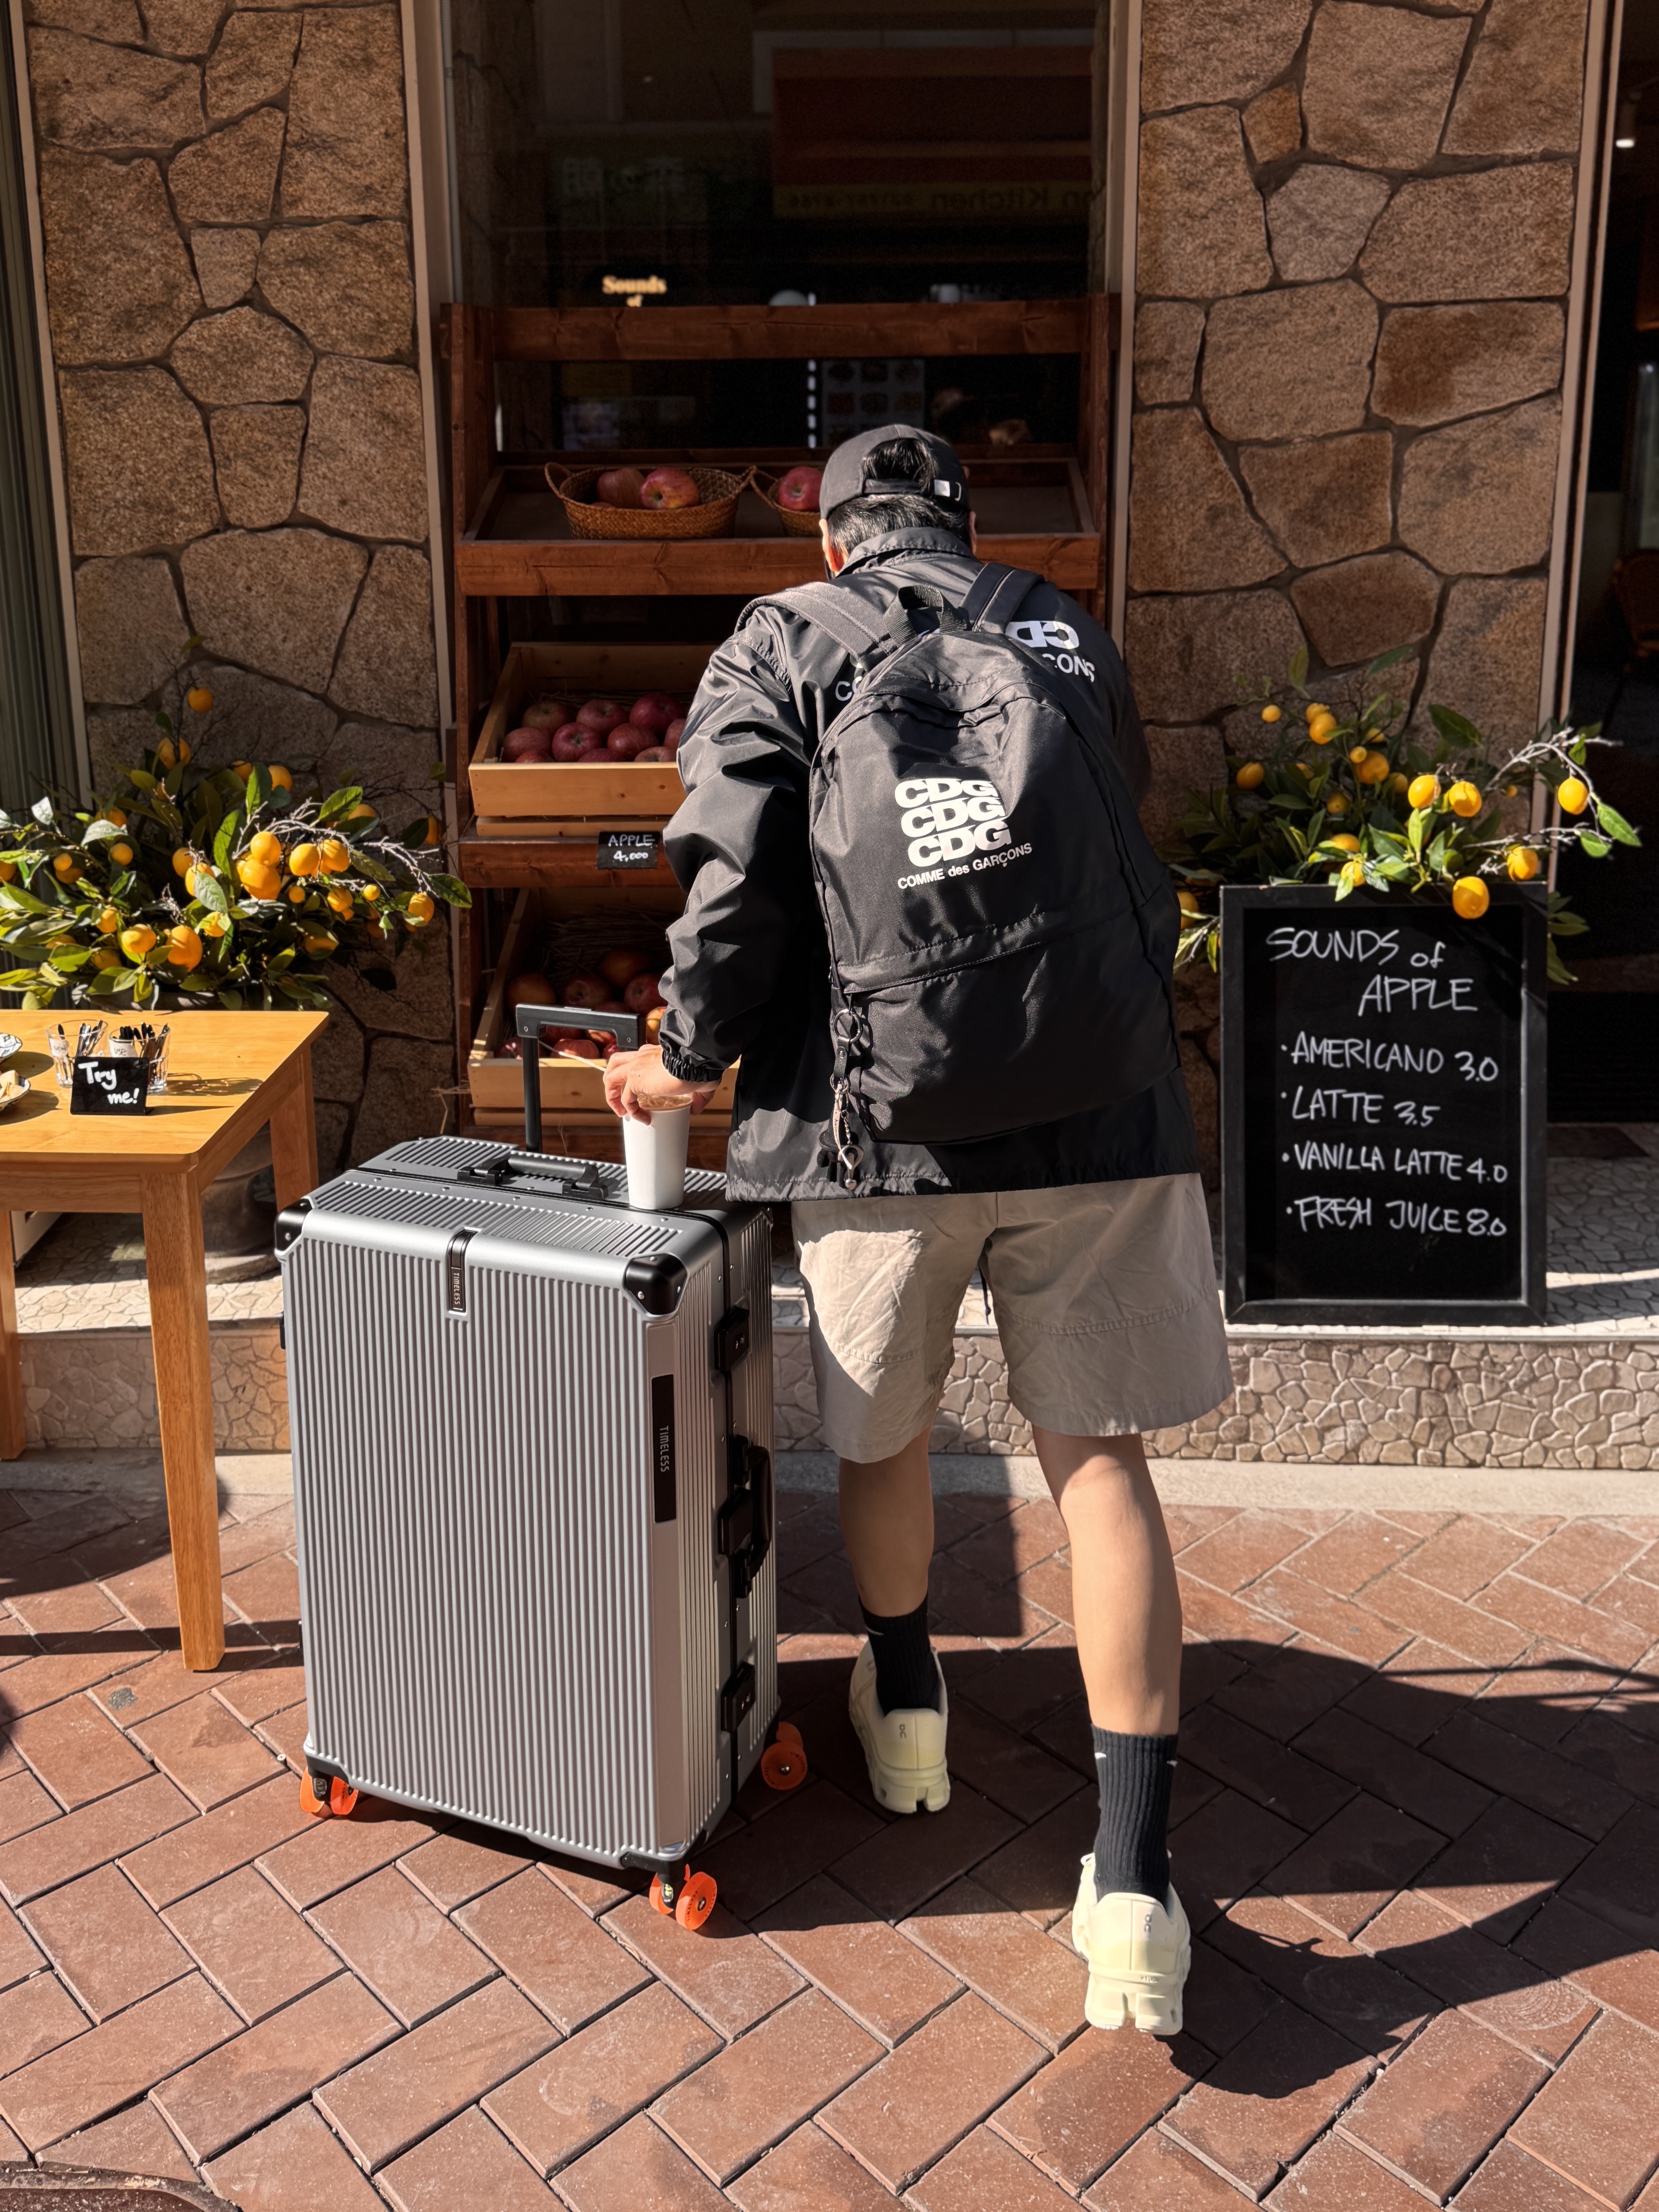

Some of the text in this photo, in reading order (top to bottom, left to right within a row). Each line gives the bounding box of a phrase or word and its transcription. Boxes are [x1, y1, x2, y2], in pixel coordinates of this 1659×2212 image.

[602, 275, 667, 294] Sounds
[894, 778, 999, 808] CDG
[901, 796, 1006, 837] CDG
[608, 833, 655, 847] APPLE
[613, 850, 649, 862] 4,000
[907, 819, 1012, 867] CDG
[897, 842, 1033, 889] COMME des GARÇONS
[1266, 927, 1446, 969] SOUNDS of
[1357, 974, 1478, 1017] APPLE
[77, 1061, 117, 1090] Try
[1290, 1031, 1499, 1082] AMERICANO 3.0
[107, 1088, 140, 1104] me!
[1292, 1085, 1440, 1127] LATTE 3.5
[1294, 1140, 1508, 1184] VANILLA LATTE 4.0
[1293, 1195, 1507, 1236] FRESH JUICE 8.0
[660, 1425, 670, 1472] TIMELESS
